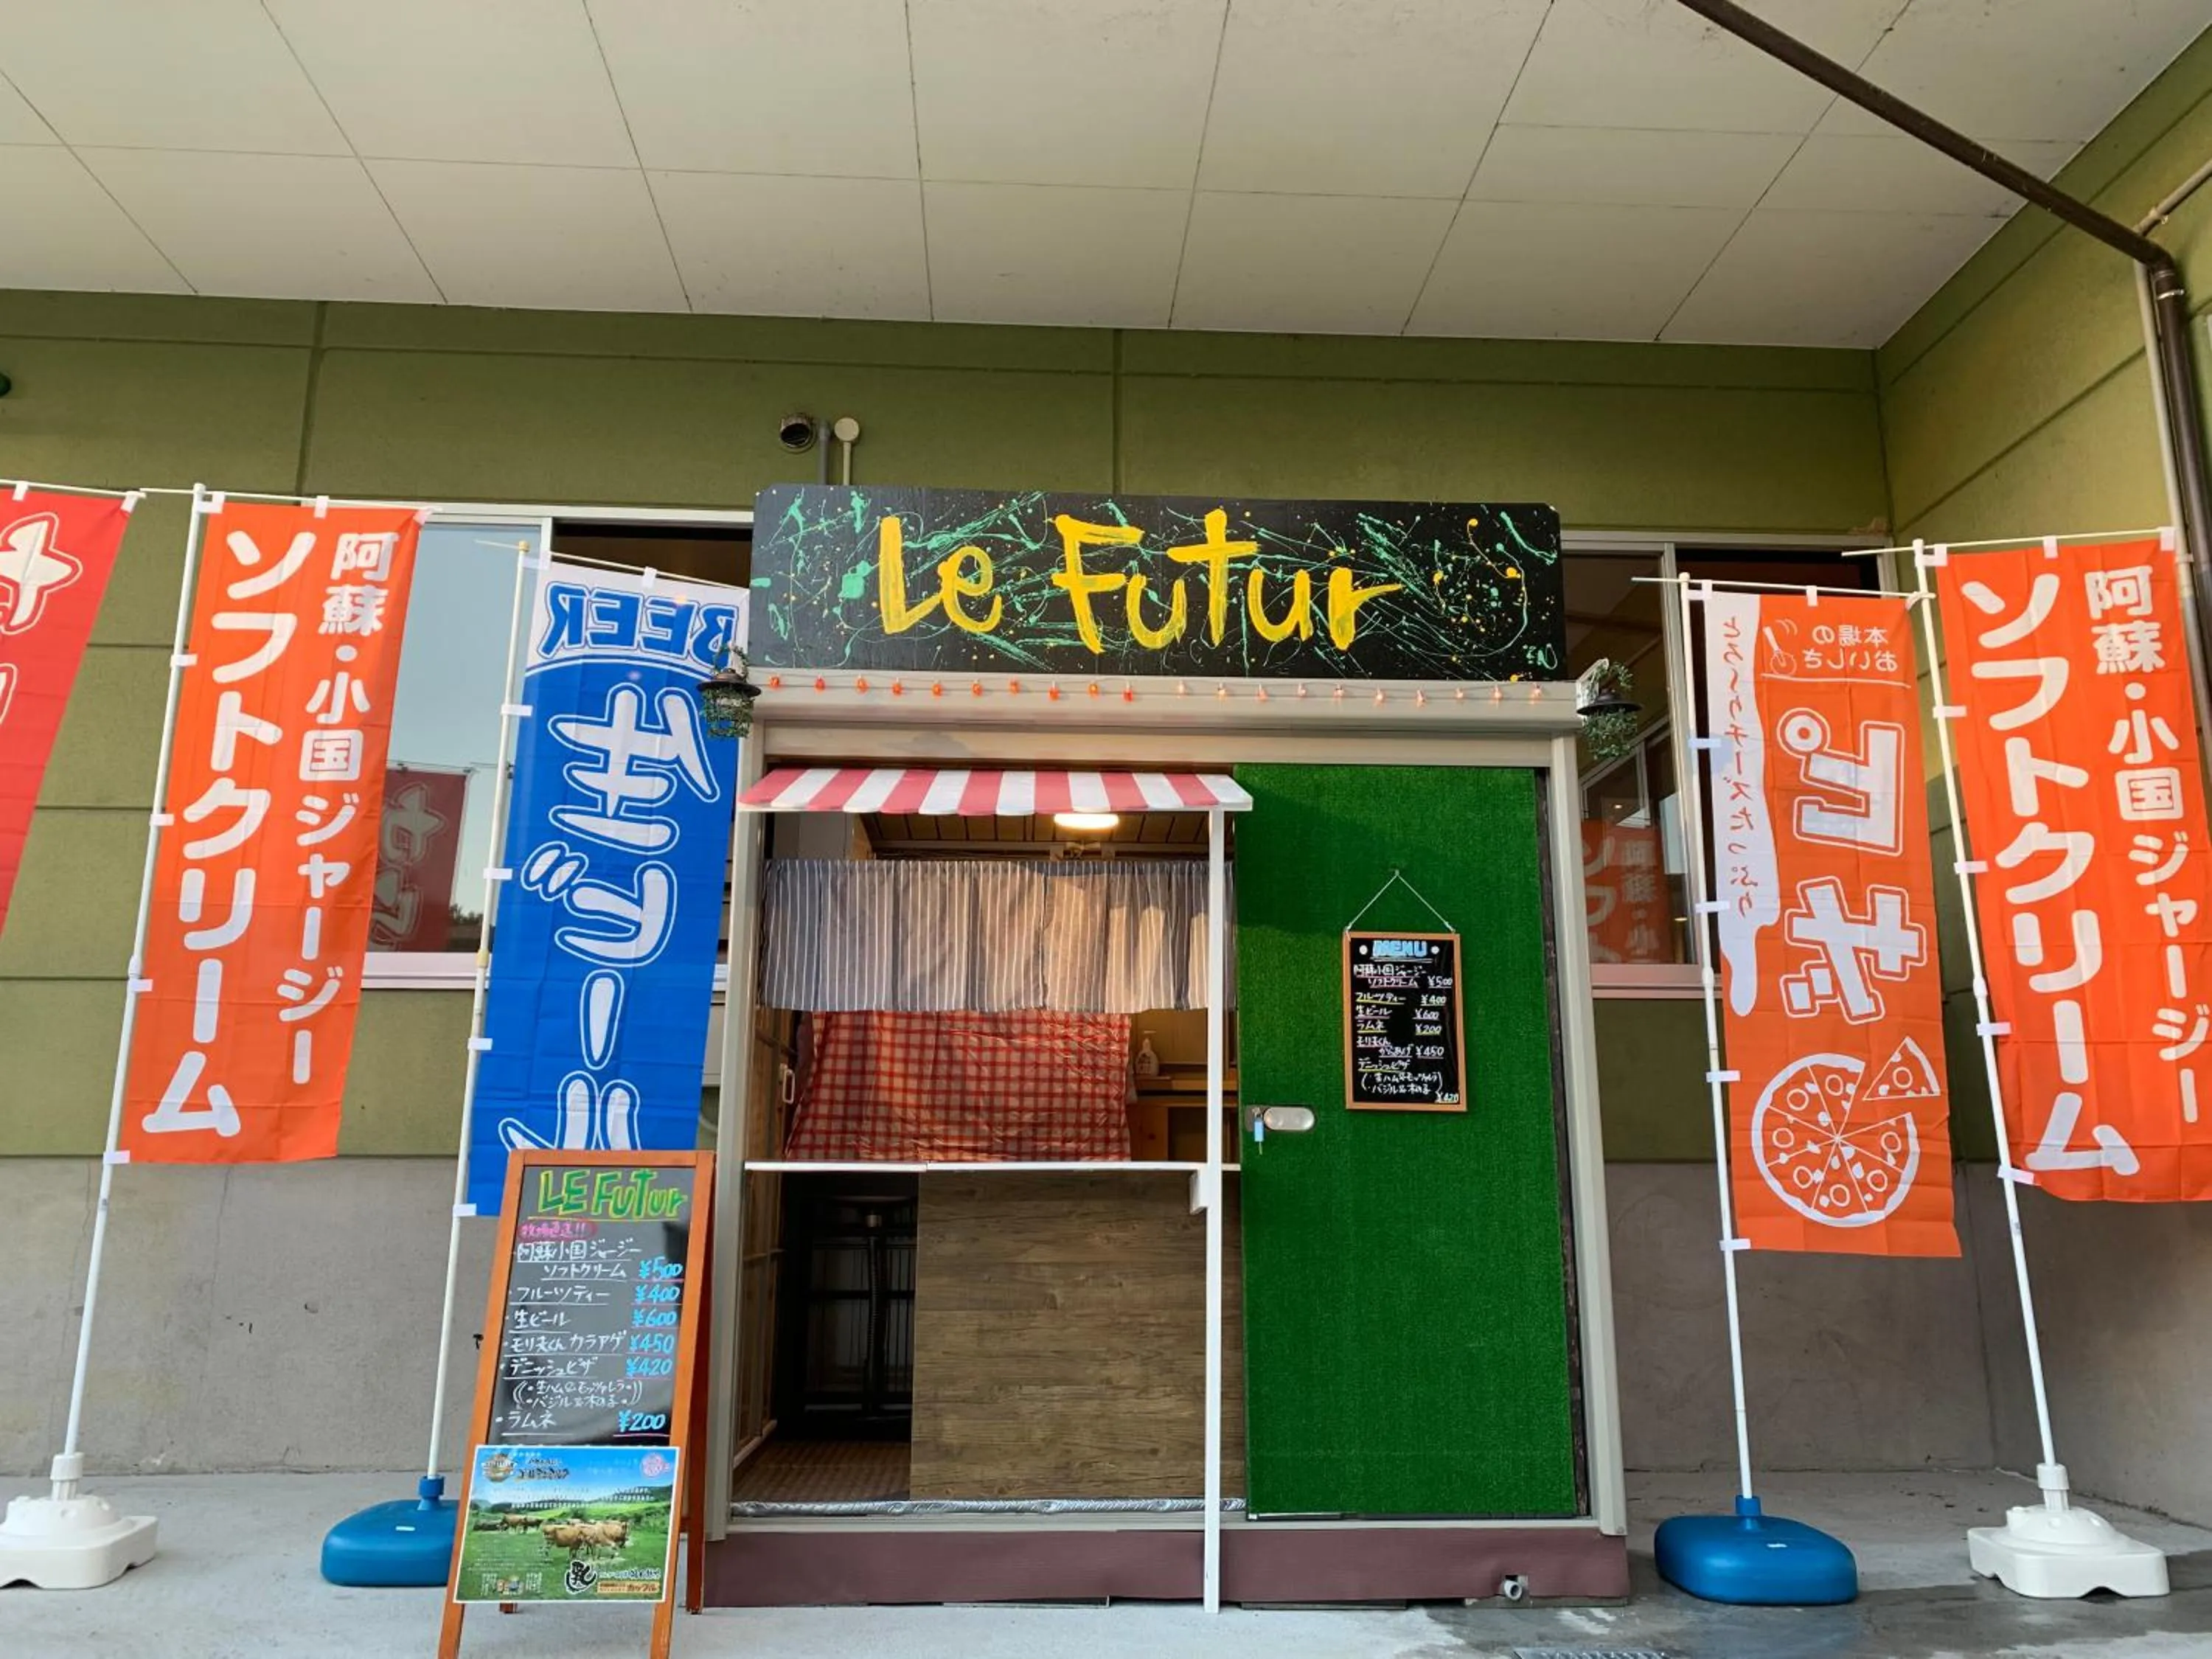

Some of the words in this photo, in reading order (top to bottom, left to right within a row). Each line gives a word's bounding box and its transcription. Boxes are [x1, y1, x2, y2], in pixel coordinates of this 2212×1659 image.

[879, 514, 1004, 636] Le
[1051, 507, 1402, 655] Futur
[276, 530, 400, 1085] 阿蘇・小国ジャージー
[142, 529, 317, 1137] ソフトクリーム
[2084, 565, 2211, 1123] 阿蘇・小国ジャージー
[1961, 573, 2140, 1176] ソフトクリーム
[1372, 940, 1427, 957] MENU
[1355, 1004, 1393, 1017] 生ビール
[1356, 1019, 1385, 1032] ラムネ
[1415, 1044, 1444, 1057] ¥450
[538, 1169, 589, 1215] LE
[544, 1262, 626, 1278] ソフトクリーム
[639, 1256, 684, 1280] ¥500
[517, 1285, 611, 1301] フルーツティー
[636, 1283, 681, 1301] ¥400
[514, 1309, 571, 1329] 生ビール
[632, 1310, 677, 1326] ¥600
[630, 1333, 675, 1353] ¥450
[626, 1357, 673, 1377] ¥420
[507, 1410, 557, 1429] ラムネ
[618, 1409, 667, 1433] ¥200
